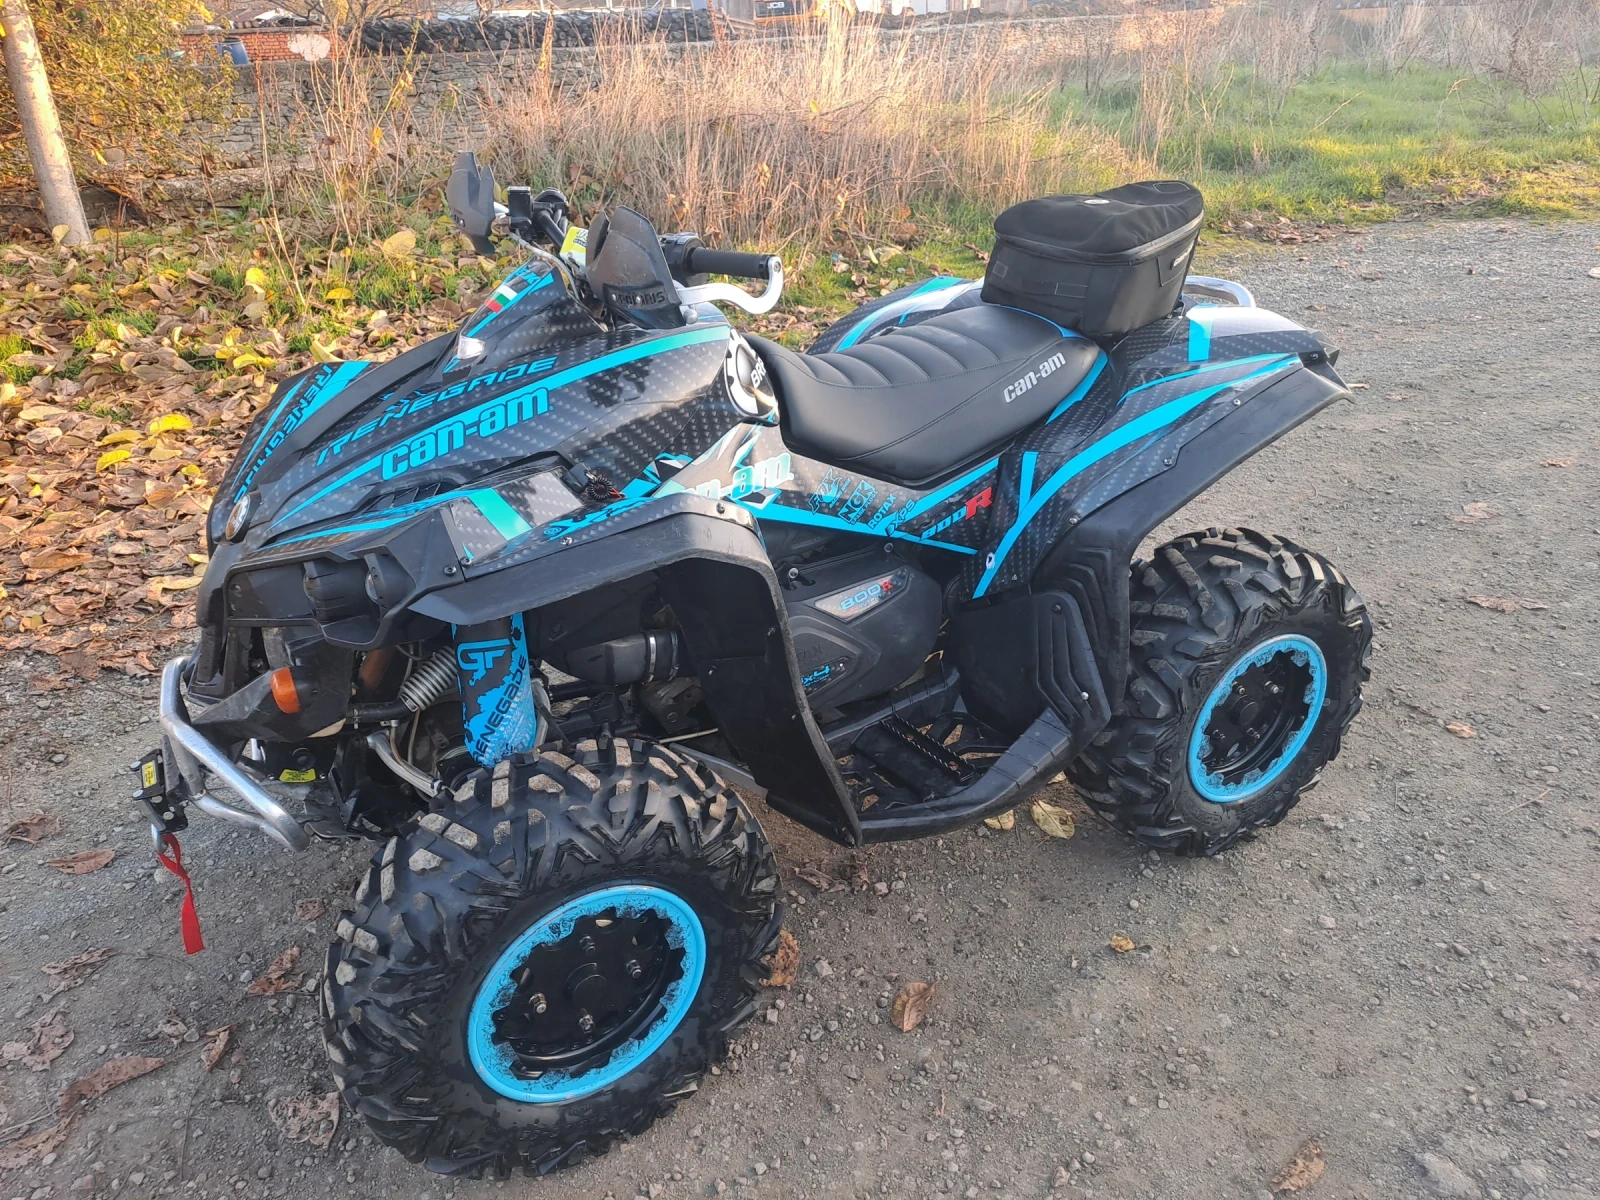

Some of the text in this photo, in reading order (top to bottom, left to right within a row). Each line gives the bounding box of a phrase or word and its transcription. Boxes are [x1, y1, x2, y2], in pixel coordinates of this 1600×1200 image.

[316, 356, 558, 468] RENEGADE
[838, 480, 875, 524] NGK
[867, 493, 897, 530] ROTAX
[889, 499, 917, 530] XPS
[840, 579, 894, 610] 800R
